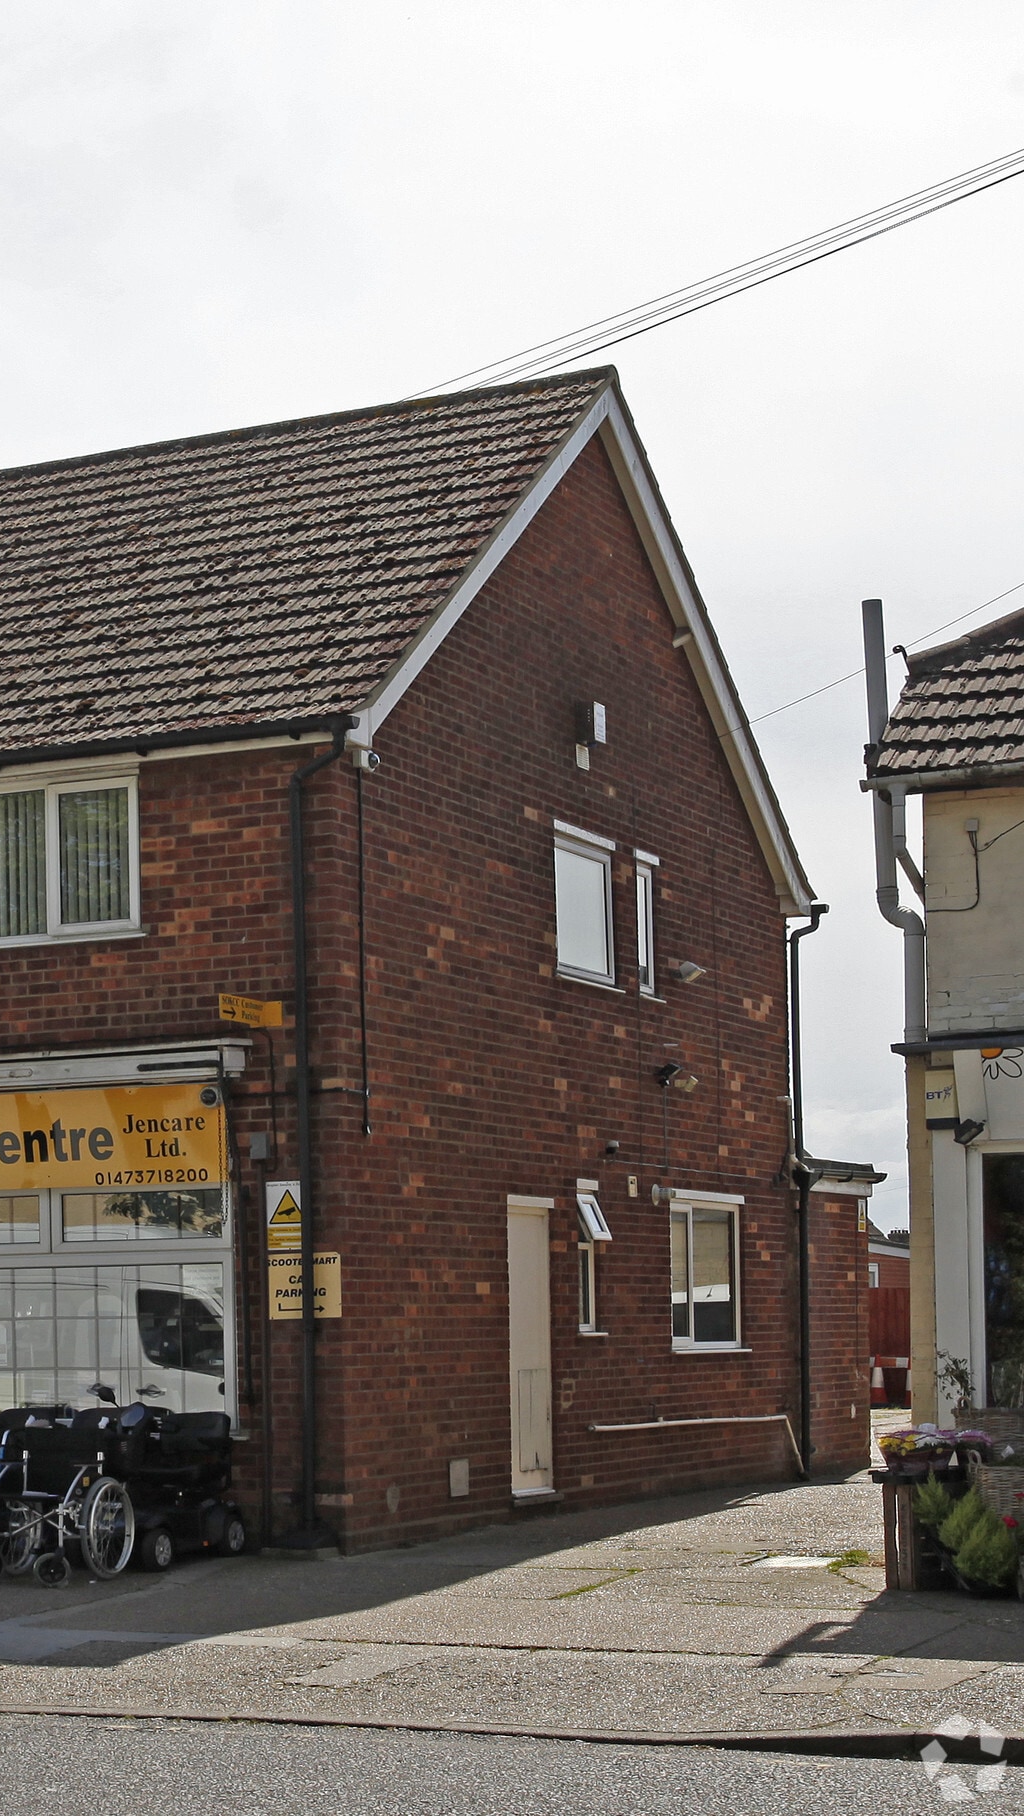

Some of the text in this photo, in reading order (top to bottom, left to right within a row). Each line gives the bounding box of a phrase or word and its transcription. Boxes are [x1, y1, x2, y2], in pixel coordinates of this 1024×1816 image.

[241, 1010, 261, 1023] Parking
[926, 1091, 943, 1100] BT
[122, 1113, 206, 1134] Jencare
[144, 1137, 187, 1160] Ltd.
[94, 1168, 209, 1186] 01473718200
